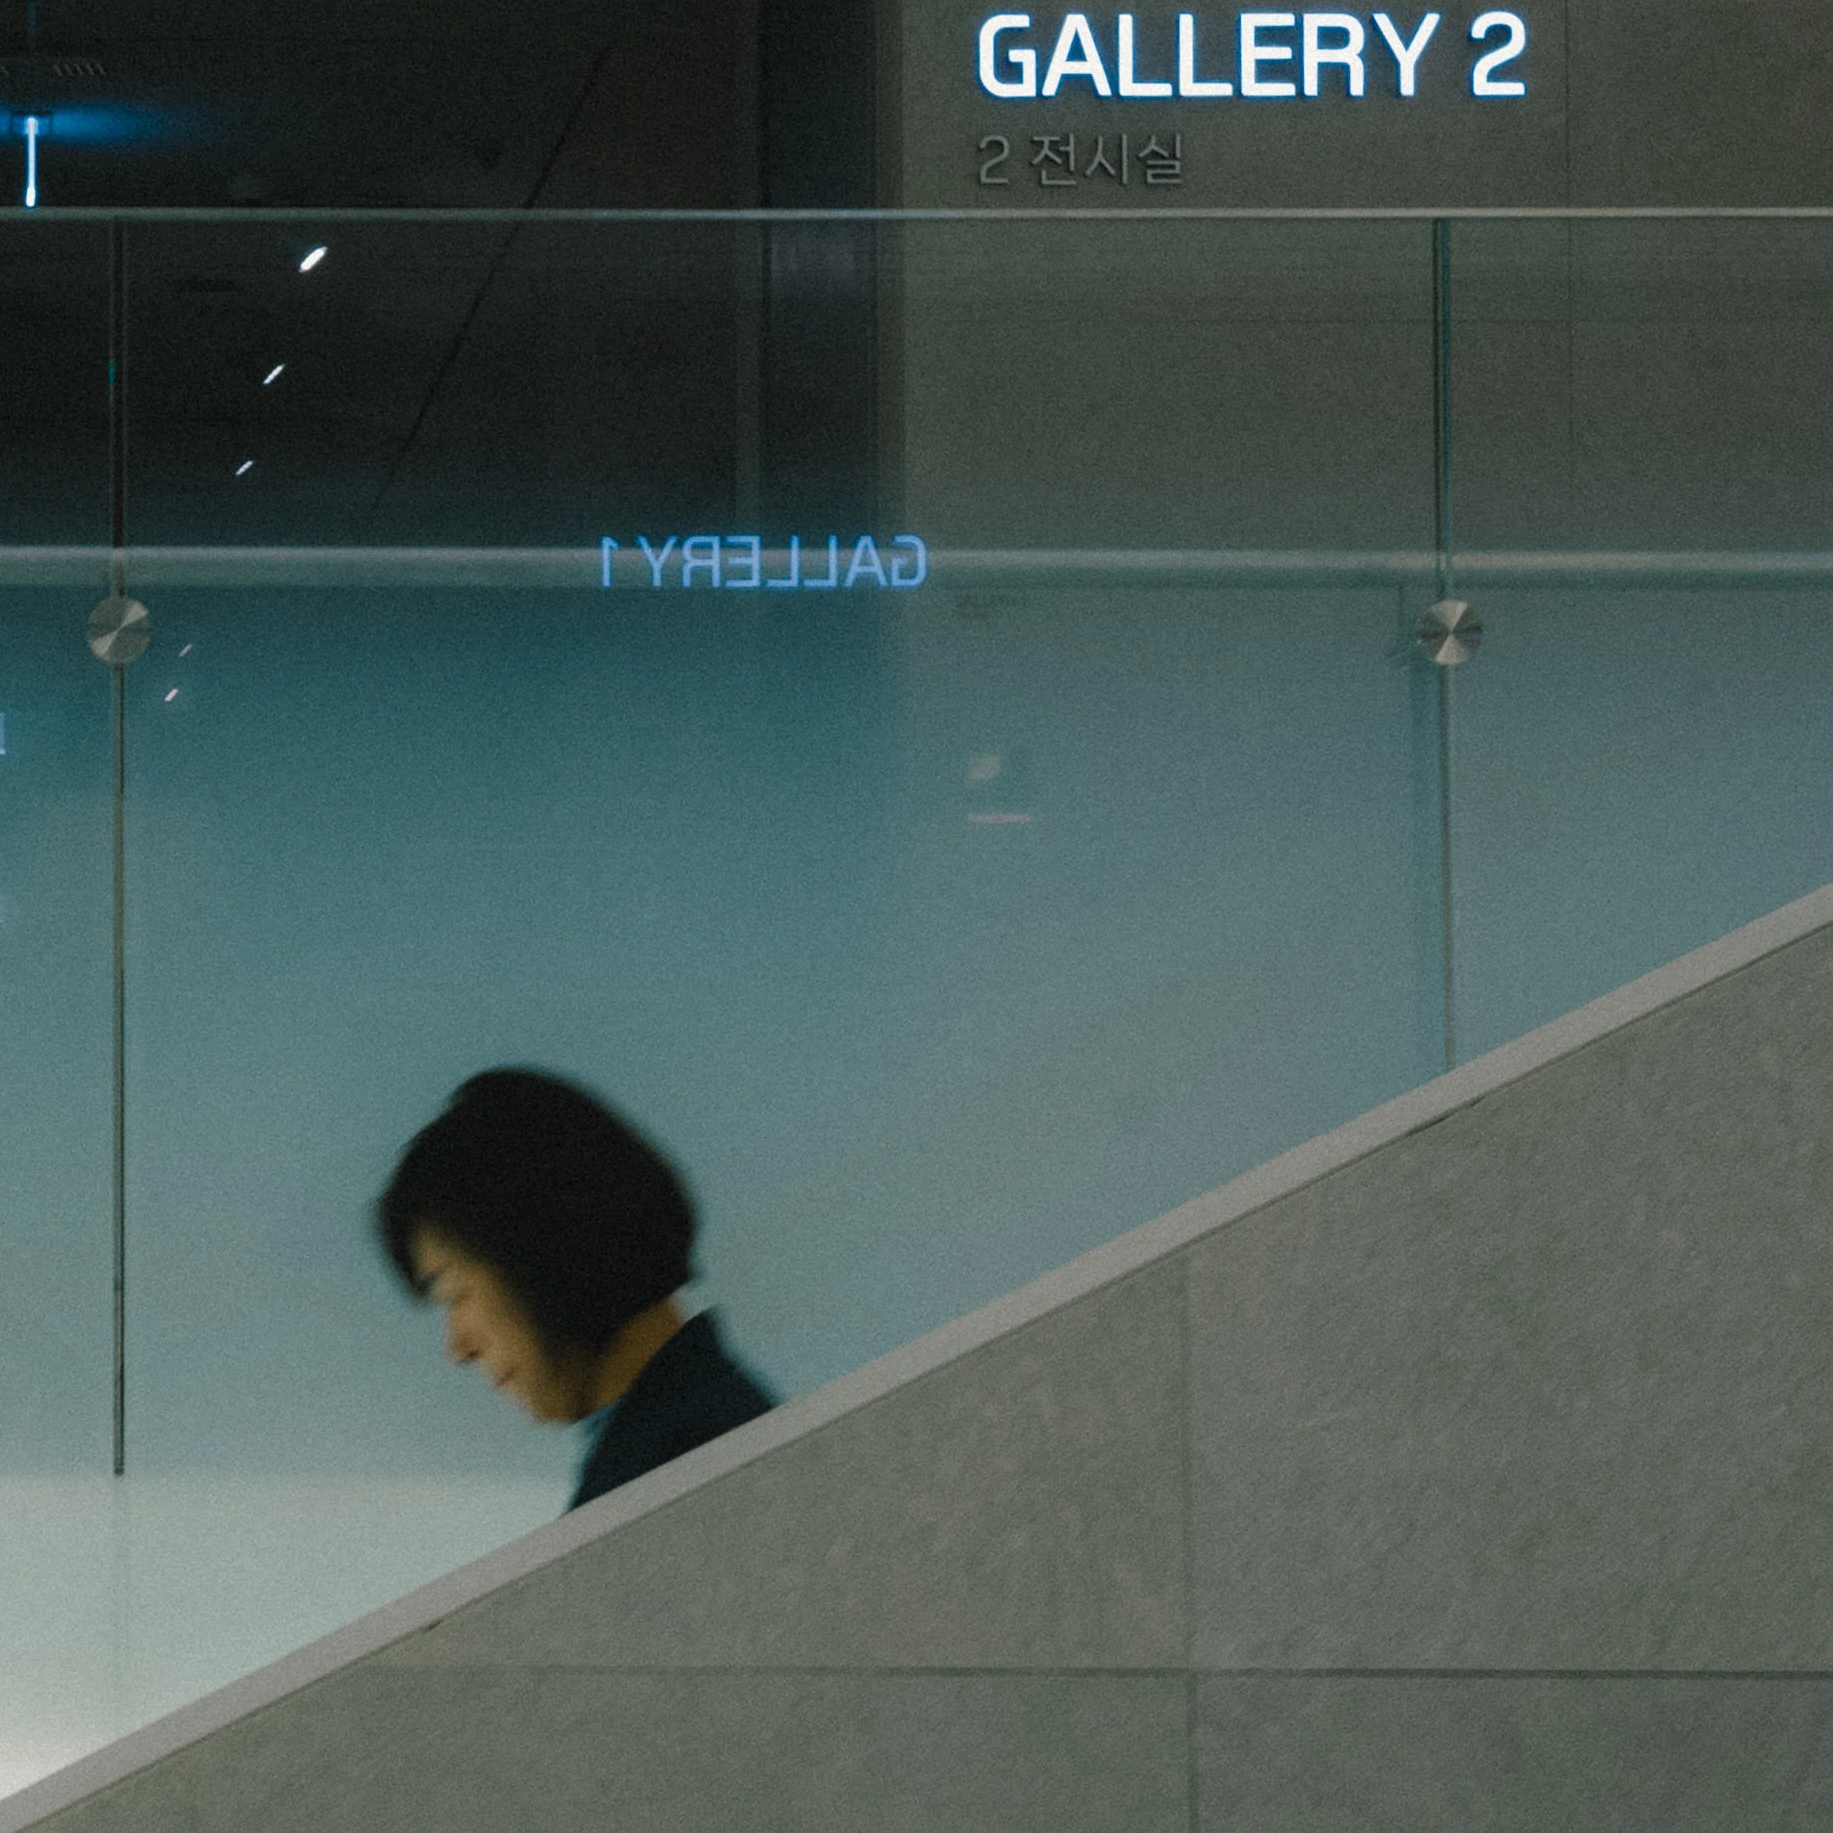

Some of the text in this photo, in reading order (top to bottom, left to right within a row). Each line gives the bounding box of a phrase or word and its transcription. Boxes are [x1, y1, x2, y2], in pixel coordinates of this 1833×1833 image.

[977, 11, 1528, 99] GALLERY 2
[978, 133, 1186, 188] 2 전시실
